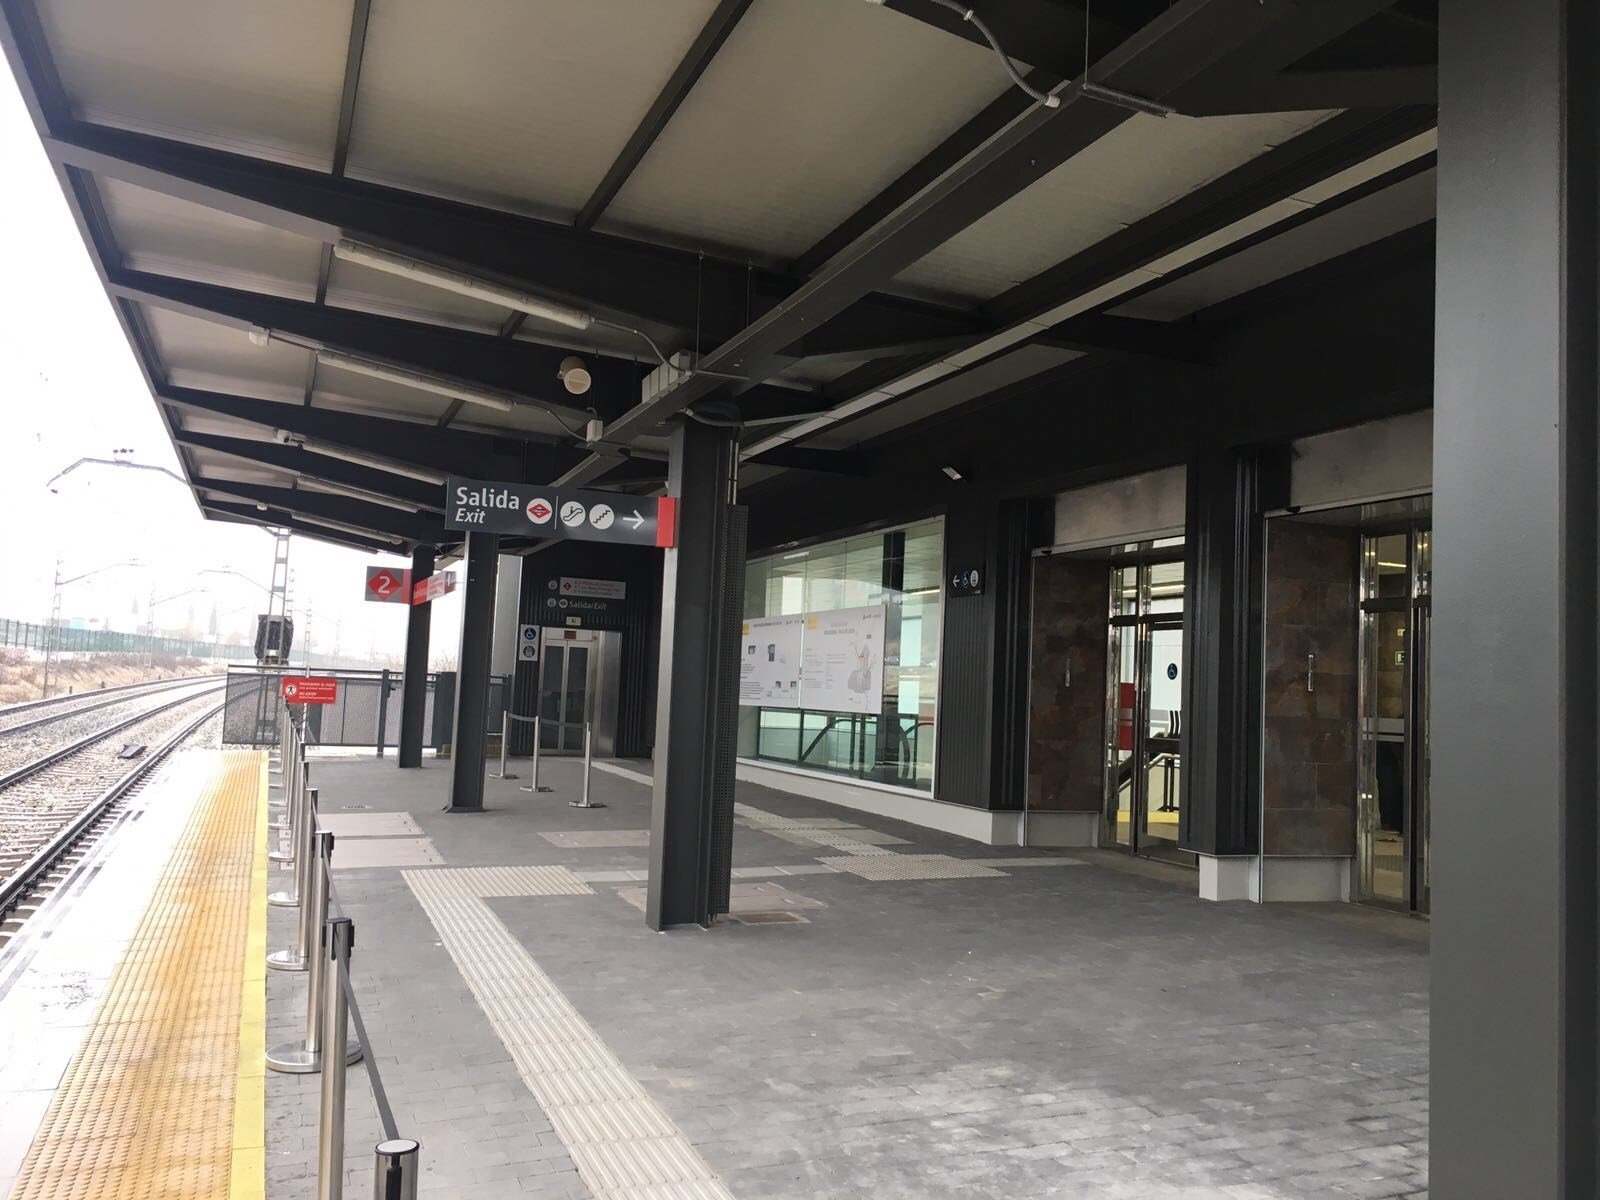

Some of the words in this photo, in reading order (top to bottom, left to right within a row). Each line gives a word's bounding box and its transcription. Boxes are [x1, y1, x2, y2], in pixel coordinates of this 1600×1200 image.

[455, 486, 520, 510] Salida
[455, 508, 486, 524] Exit
[378, 576, 391, 594] 2
